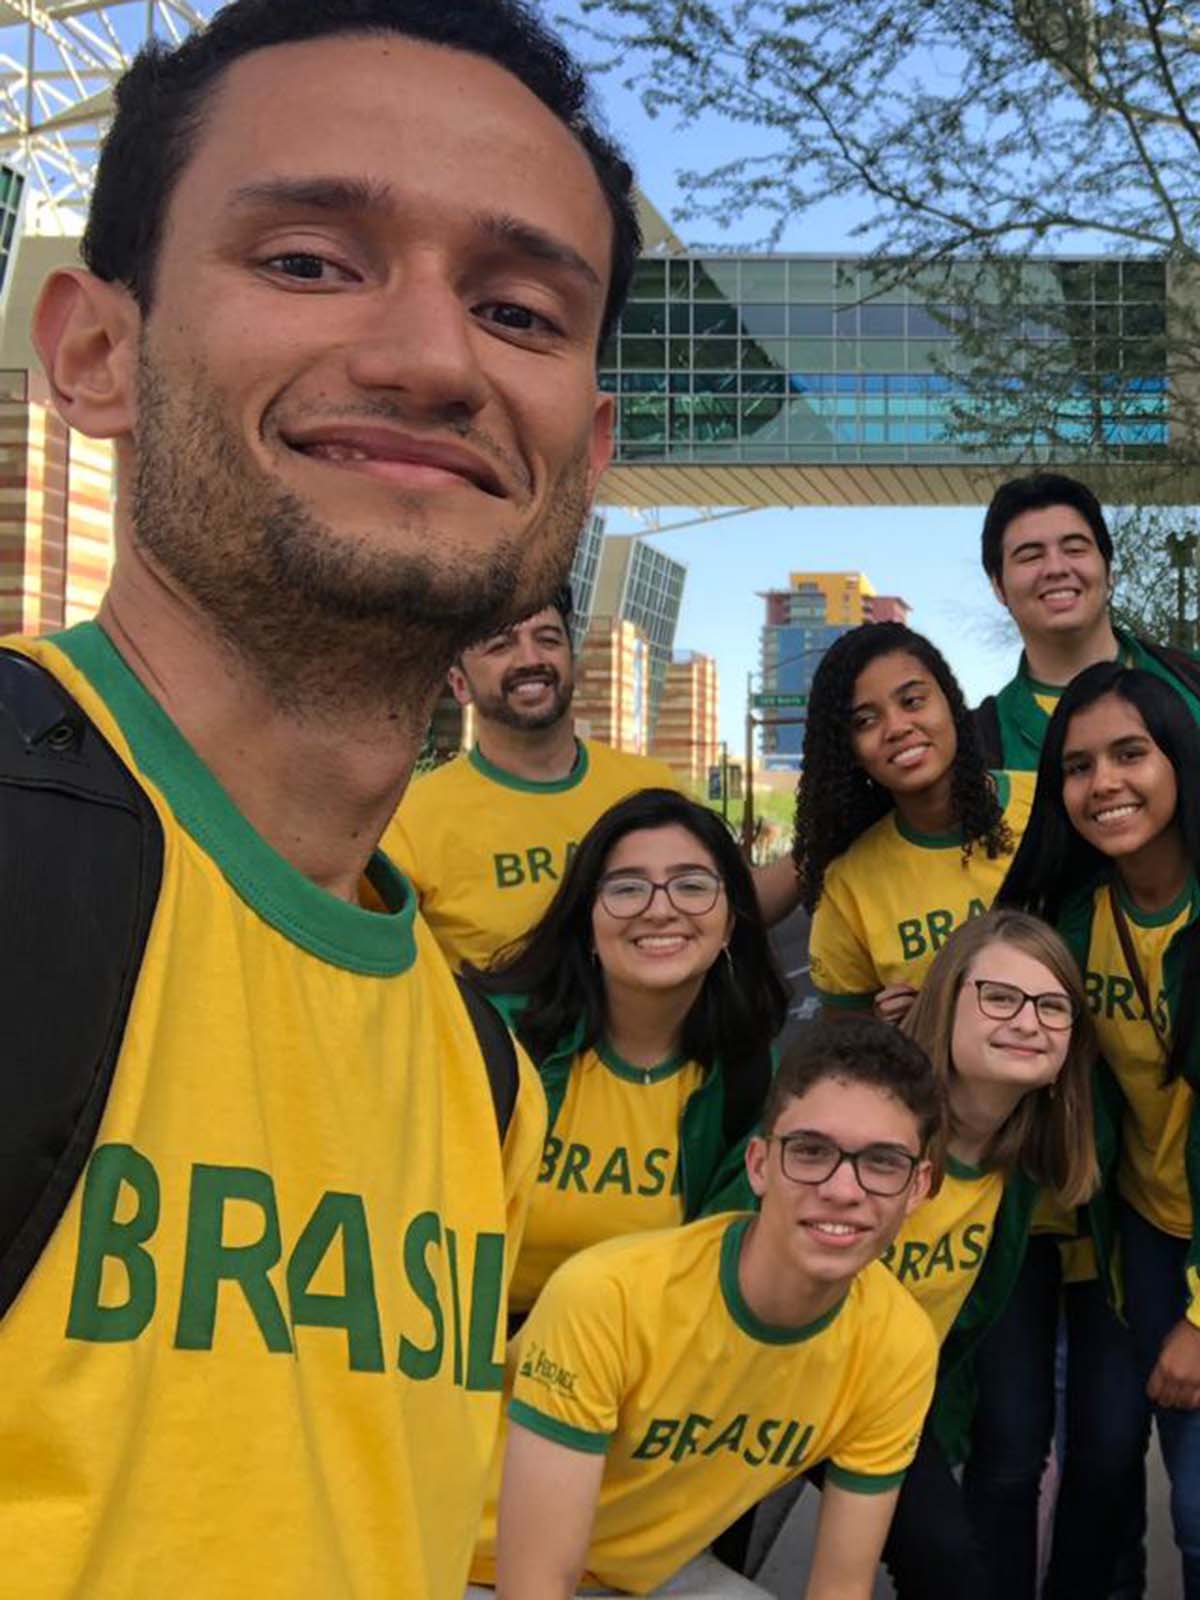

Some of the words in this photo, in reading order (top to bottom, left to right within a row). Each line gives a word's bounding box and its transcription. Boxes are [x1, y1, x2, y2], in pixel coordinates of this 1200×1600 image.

[898, 898, 987, 961] BRA
[66, 1143, 505, 1392] BRASIL
[631, 1413, 815, 1467] BRASIL
